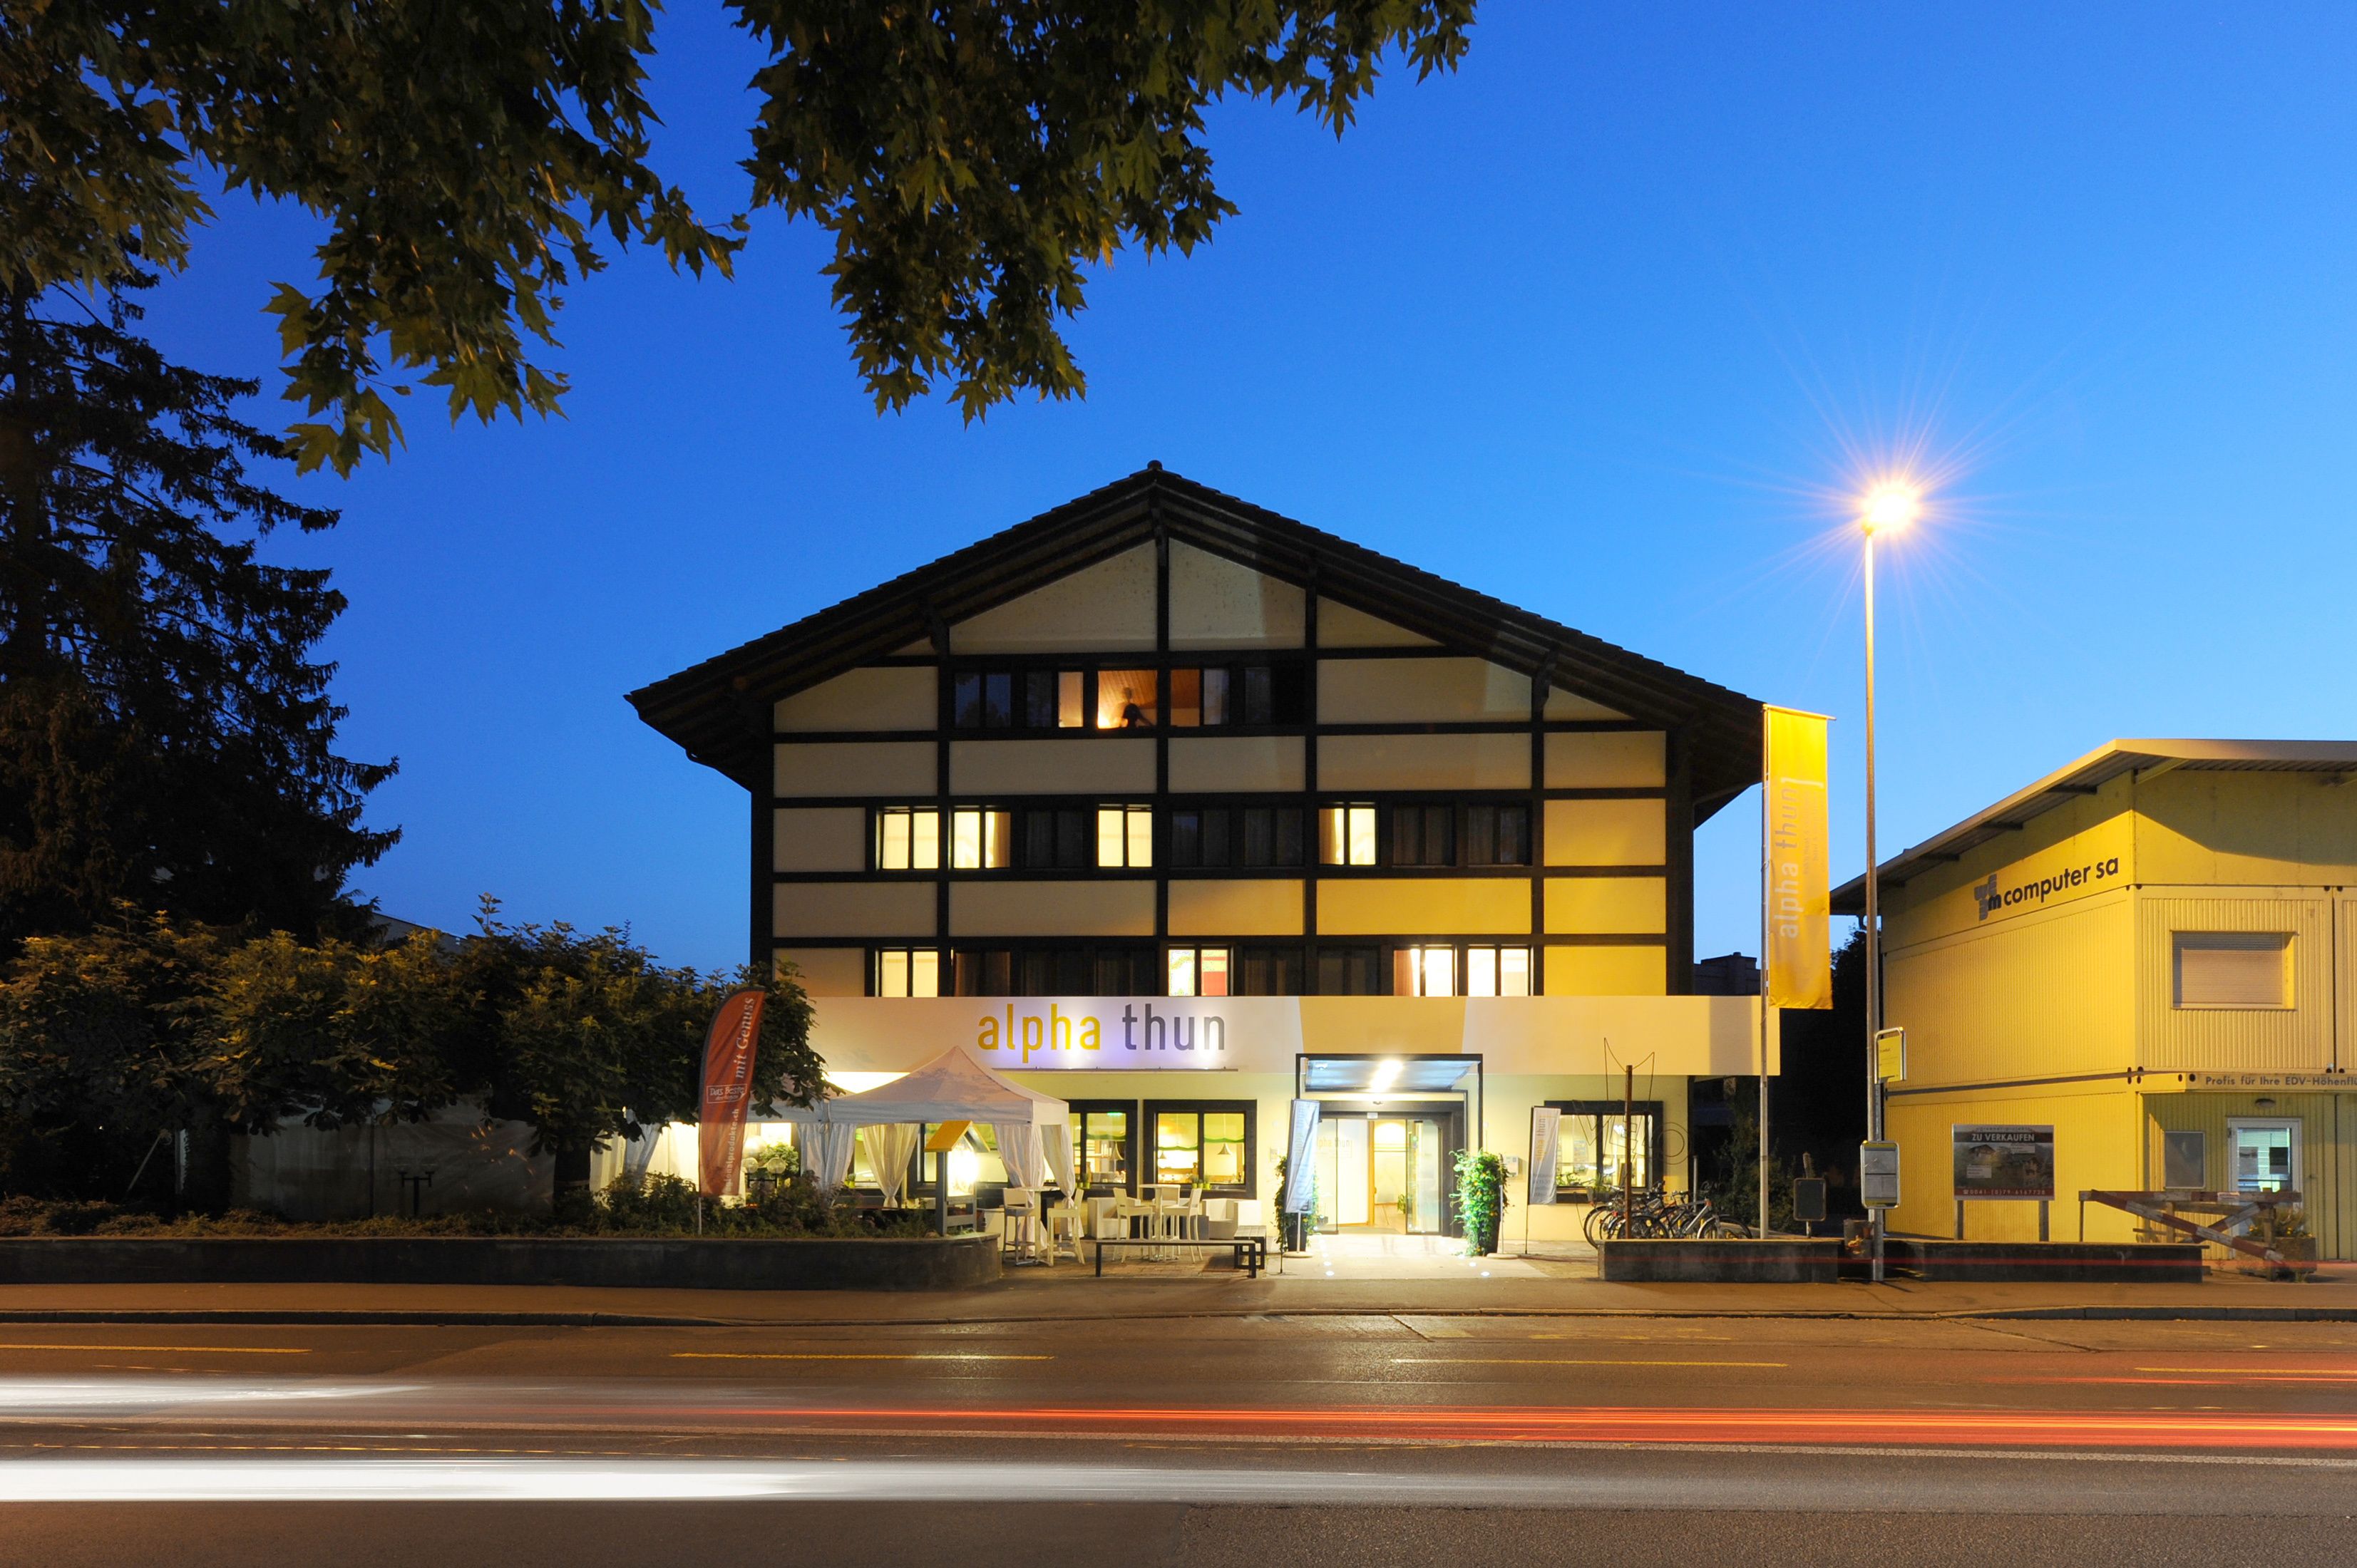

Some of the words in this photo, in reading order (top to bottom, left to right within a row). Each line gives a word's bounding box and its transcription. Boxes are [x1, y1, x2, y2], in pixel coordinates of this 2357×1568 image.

[1774, 862, 1805, 939] alpha
[2004, 865, 2091, 904] computer
[2095, 857, 2119, 880] sa
[736, 997, 755, 1050] Genuss
[977, 1003, 1101, 1063] alpha
[1121, 1003, 1225, 1051] thun
[733, 1053, 747, 1078] mit
[2205, 1076, 2236, 1085] Profis
[2240, 1076, 2256, 1085] für
[2259, 1076, 2281, 1085] Ihre
[709, 1088, 724, 1096] Das
